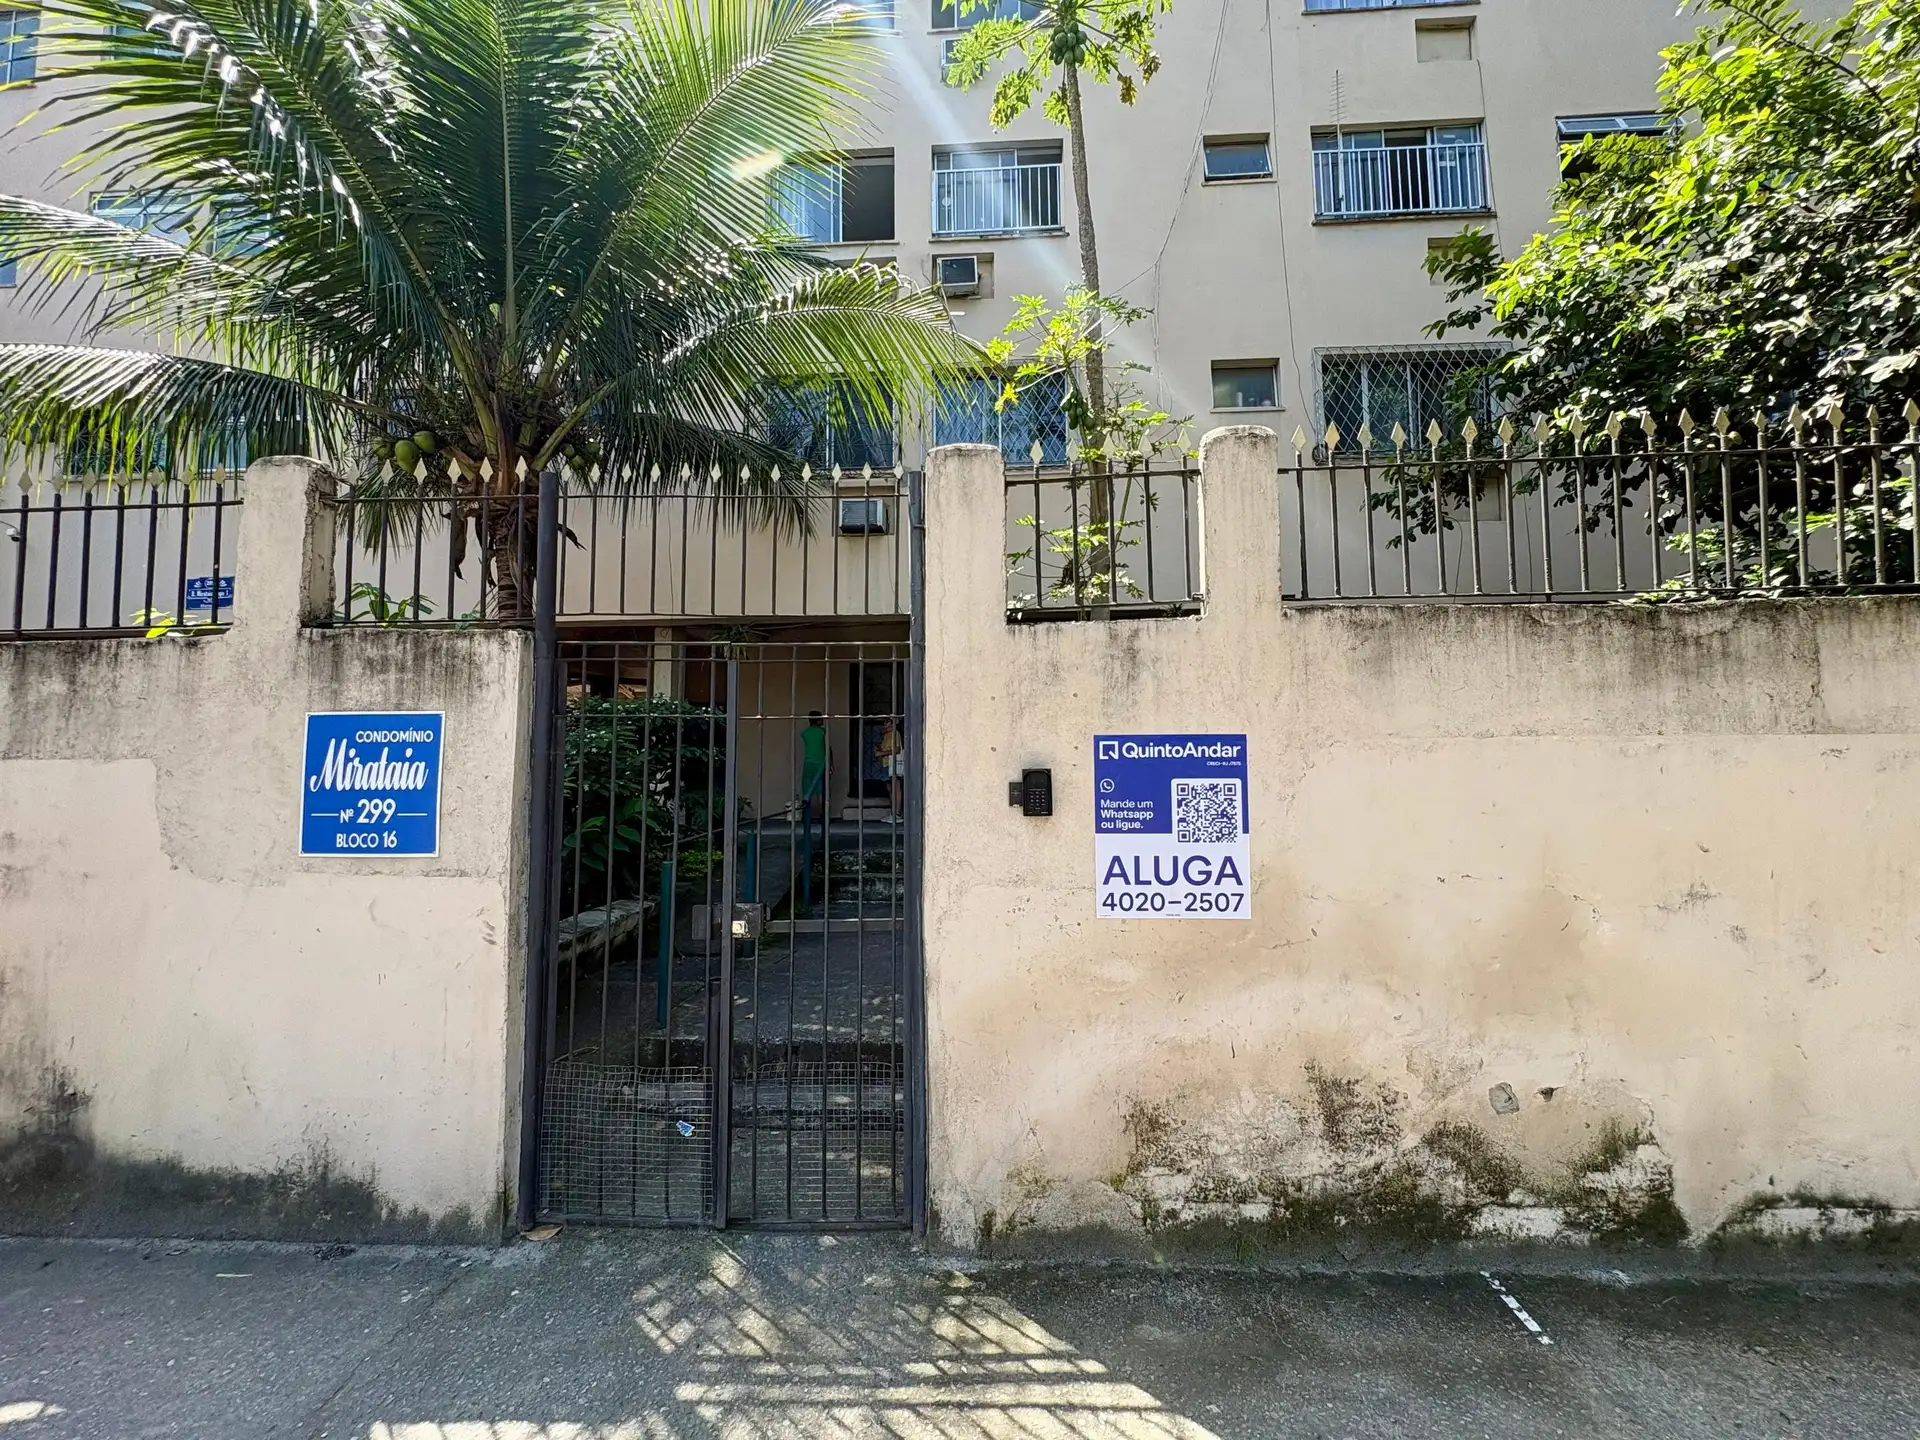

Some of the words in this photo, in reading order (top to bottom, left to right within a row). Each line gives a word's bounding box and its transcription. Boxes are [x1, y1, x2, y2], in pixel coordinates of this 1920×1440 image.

[355, 727, 434, 743] CONDOMÍNIO
[1122, 741, 1241, 759] QuintoAndar
[309, 738, 429, 792] Mirataia
[356, 798, 397, 824] 299
[1100, 799, 1135, 808] Mande
[1137, 800, 1153, 808] um
[1100, 810, 1154, 820] Whatsapp
[1101, 821, 1115, 829] ou
[1116, 820, 1144, 831] ligue.
[336, 833, 379, 848] BLOCO
[382, 830, 398, 848] 16
[1102, 855, 1243, 886] ALUGA
[1102, 892, 1245, 912] 4020-2507
